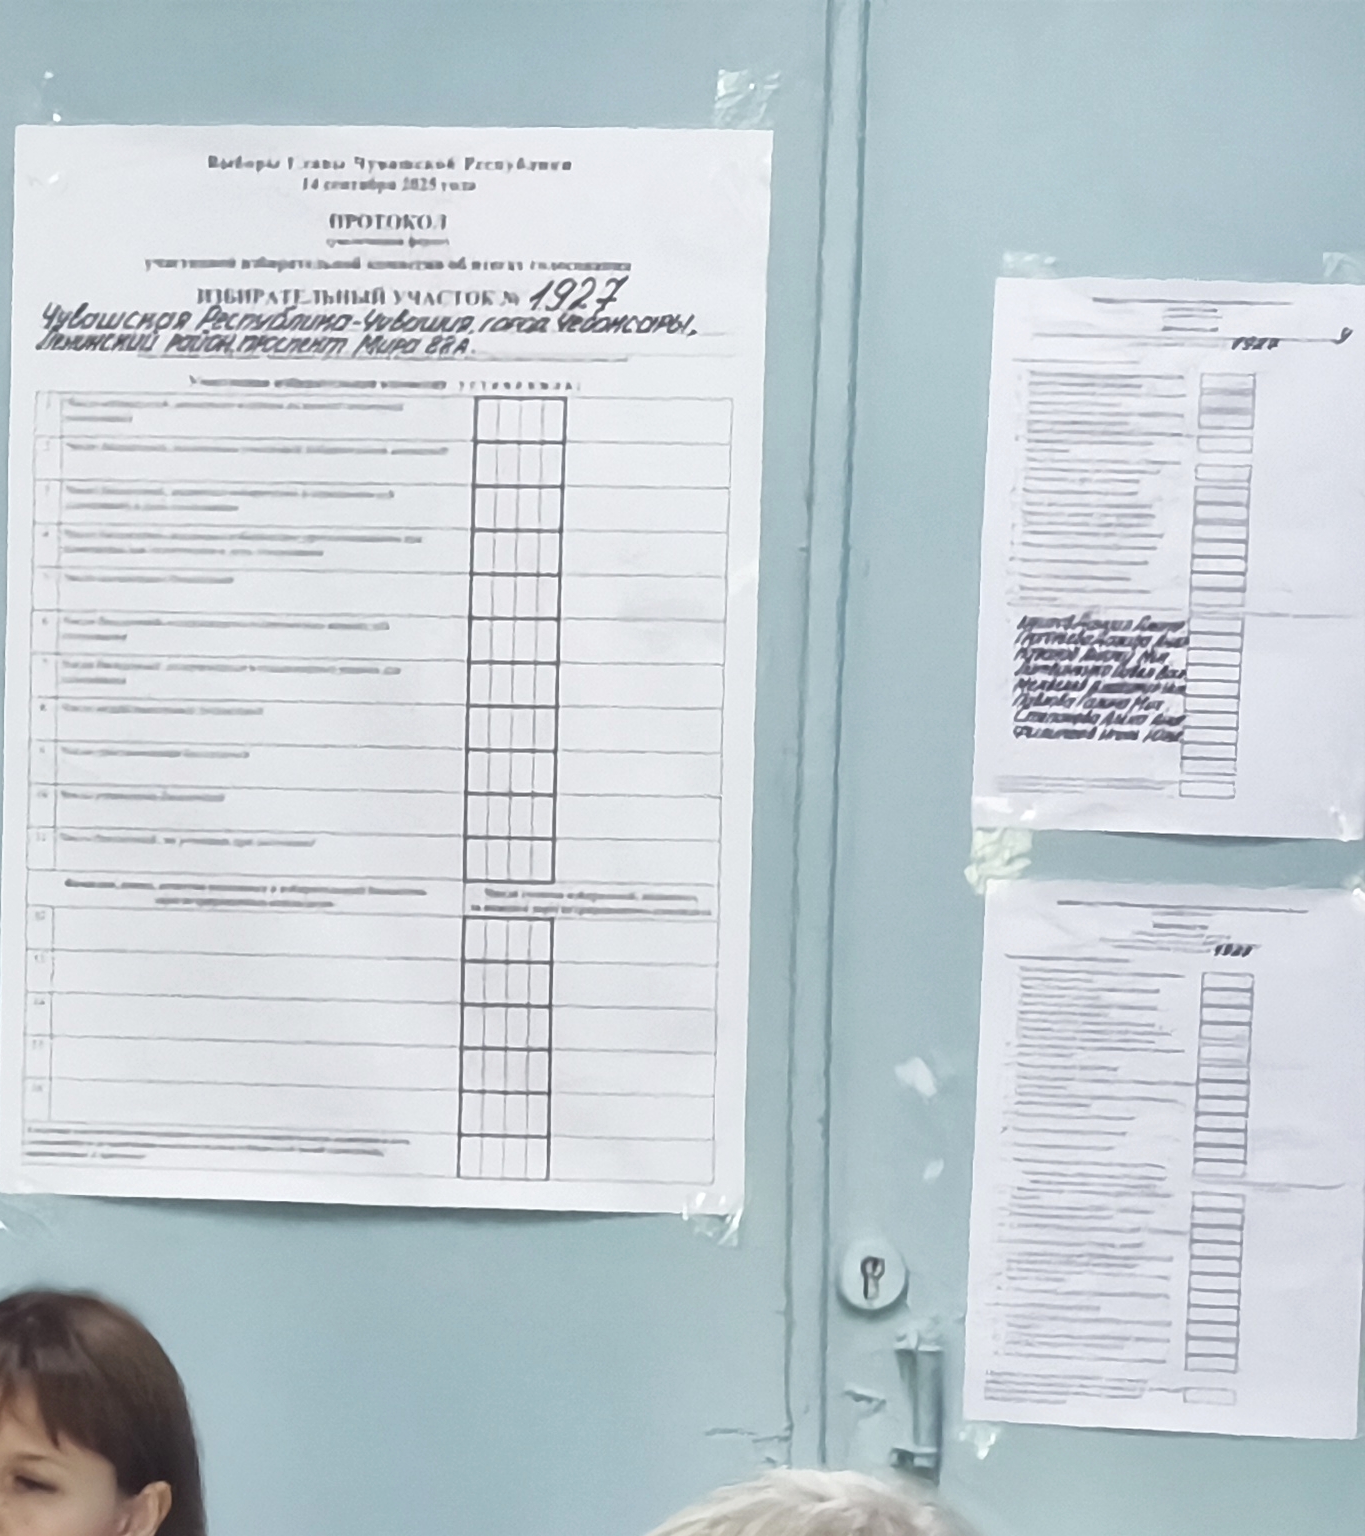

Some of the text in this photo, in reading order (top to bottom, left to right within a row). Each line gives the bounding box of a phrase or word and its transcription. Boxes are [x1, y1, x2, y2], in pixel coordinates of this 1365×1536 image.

[328, 213, 448, 231] ПРОТОКОЛ
[197, 286, 386, 306] ИЗБИРАТЕЛЬНЫЙ
[393, 289, 493, 306] УЧАСТОК
[528, 275, 630, 317] 1927
